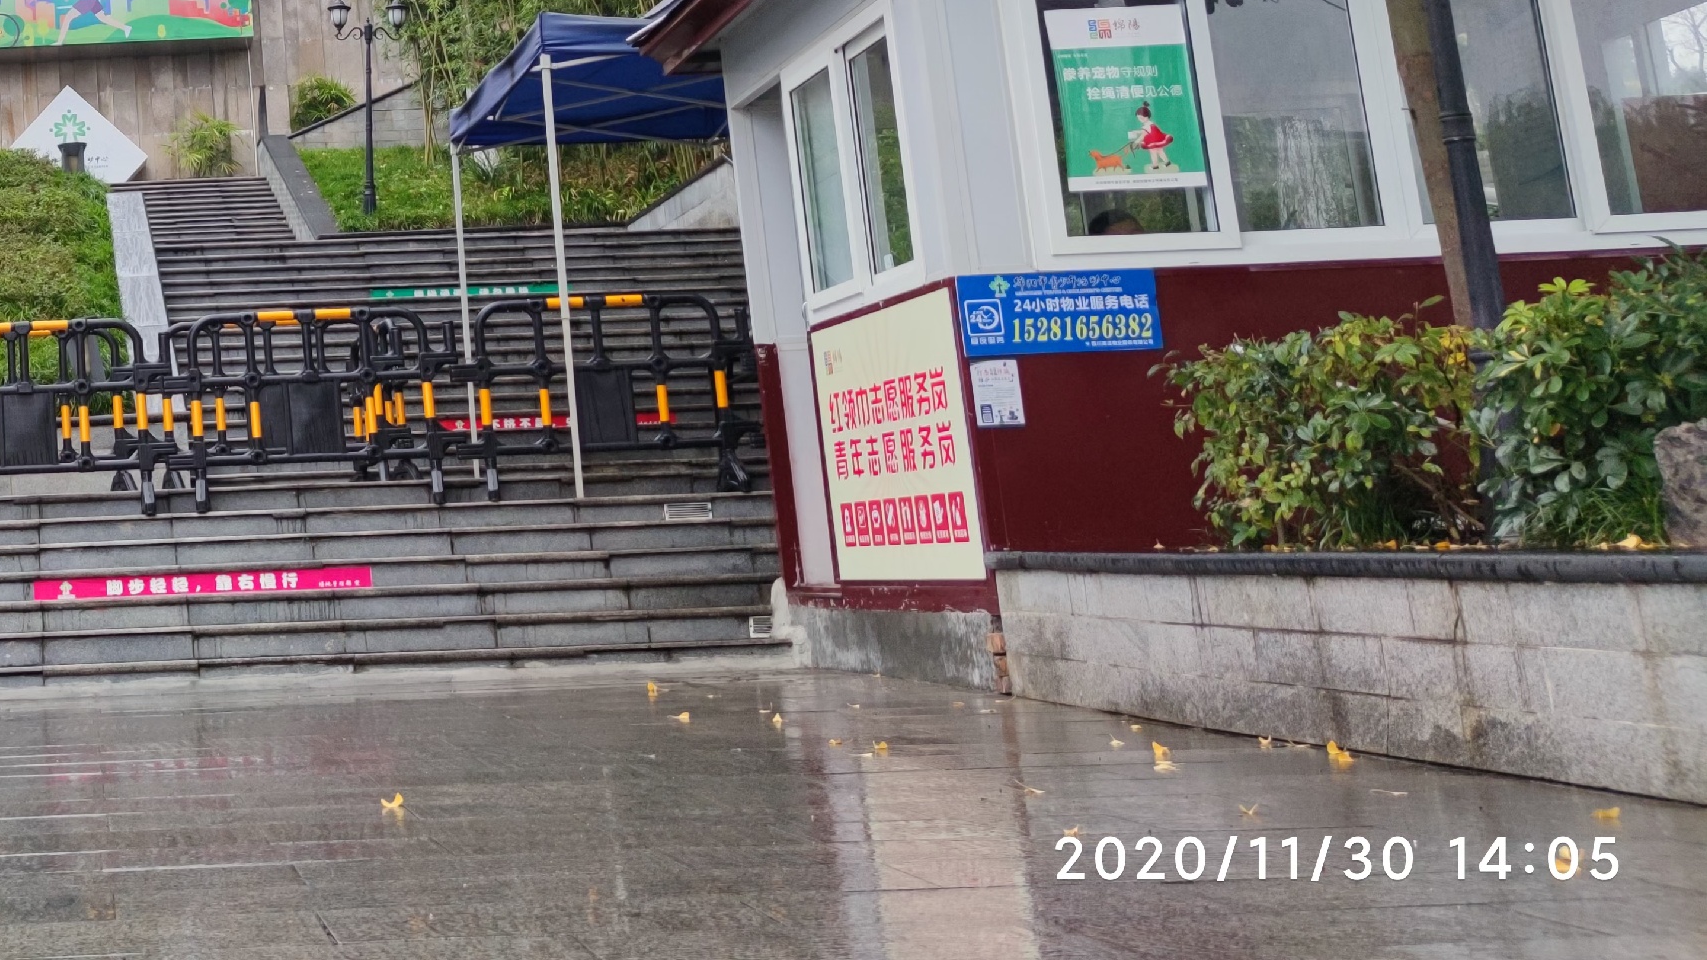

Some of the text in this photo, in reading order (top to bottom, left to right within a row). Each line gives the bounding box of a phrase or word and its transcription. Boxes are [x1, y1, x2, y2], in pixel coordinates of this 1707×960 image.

[1014, 294, 1150, 312] 24小时物业服务电话
[1013, 313, 1153, 343] 15281656382
[829, 366, 948, 433] 红领巾志愿服务岗
[833, 420, 956, 480] 青年志愿服务岗
[106, 571, 299, 596] 脚步轻轻，靠右慢行
